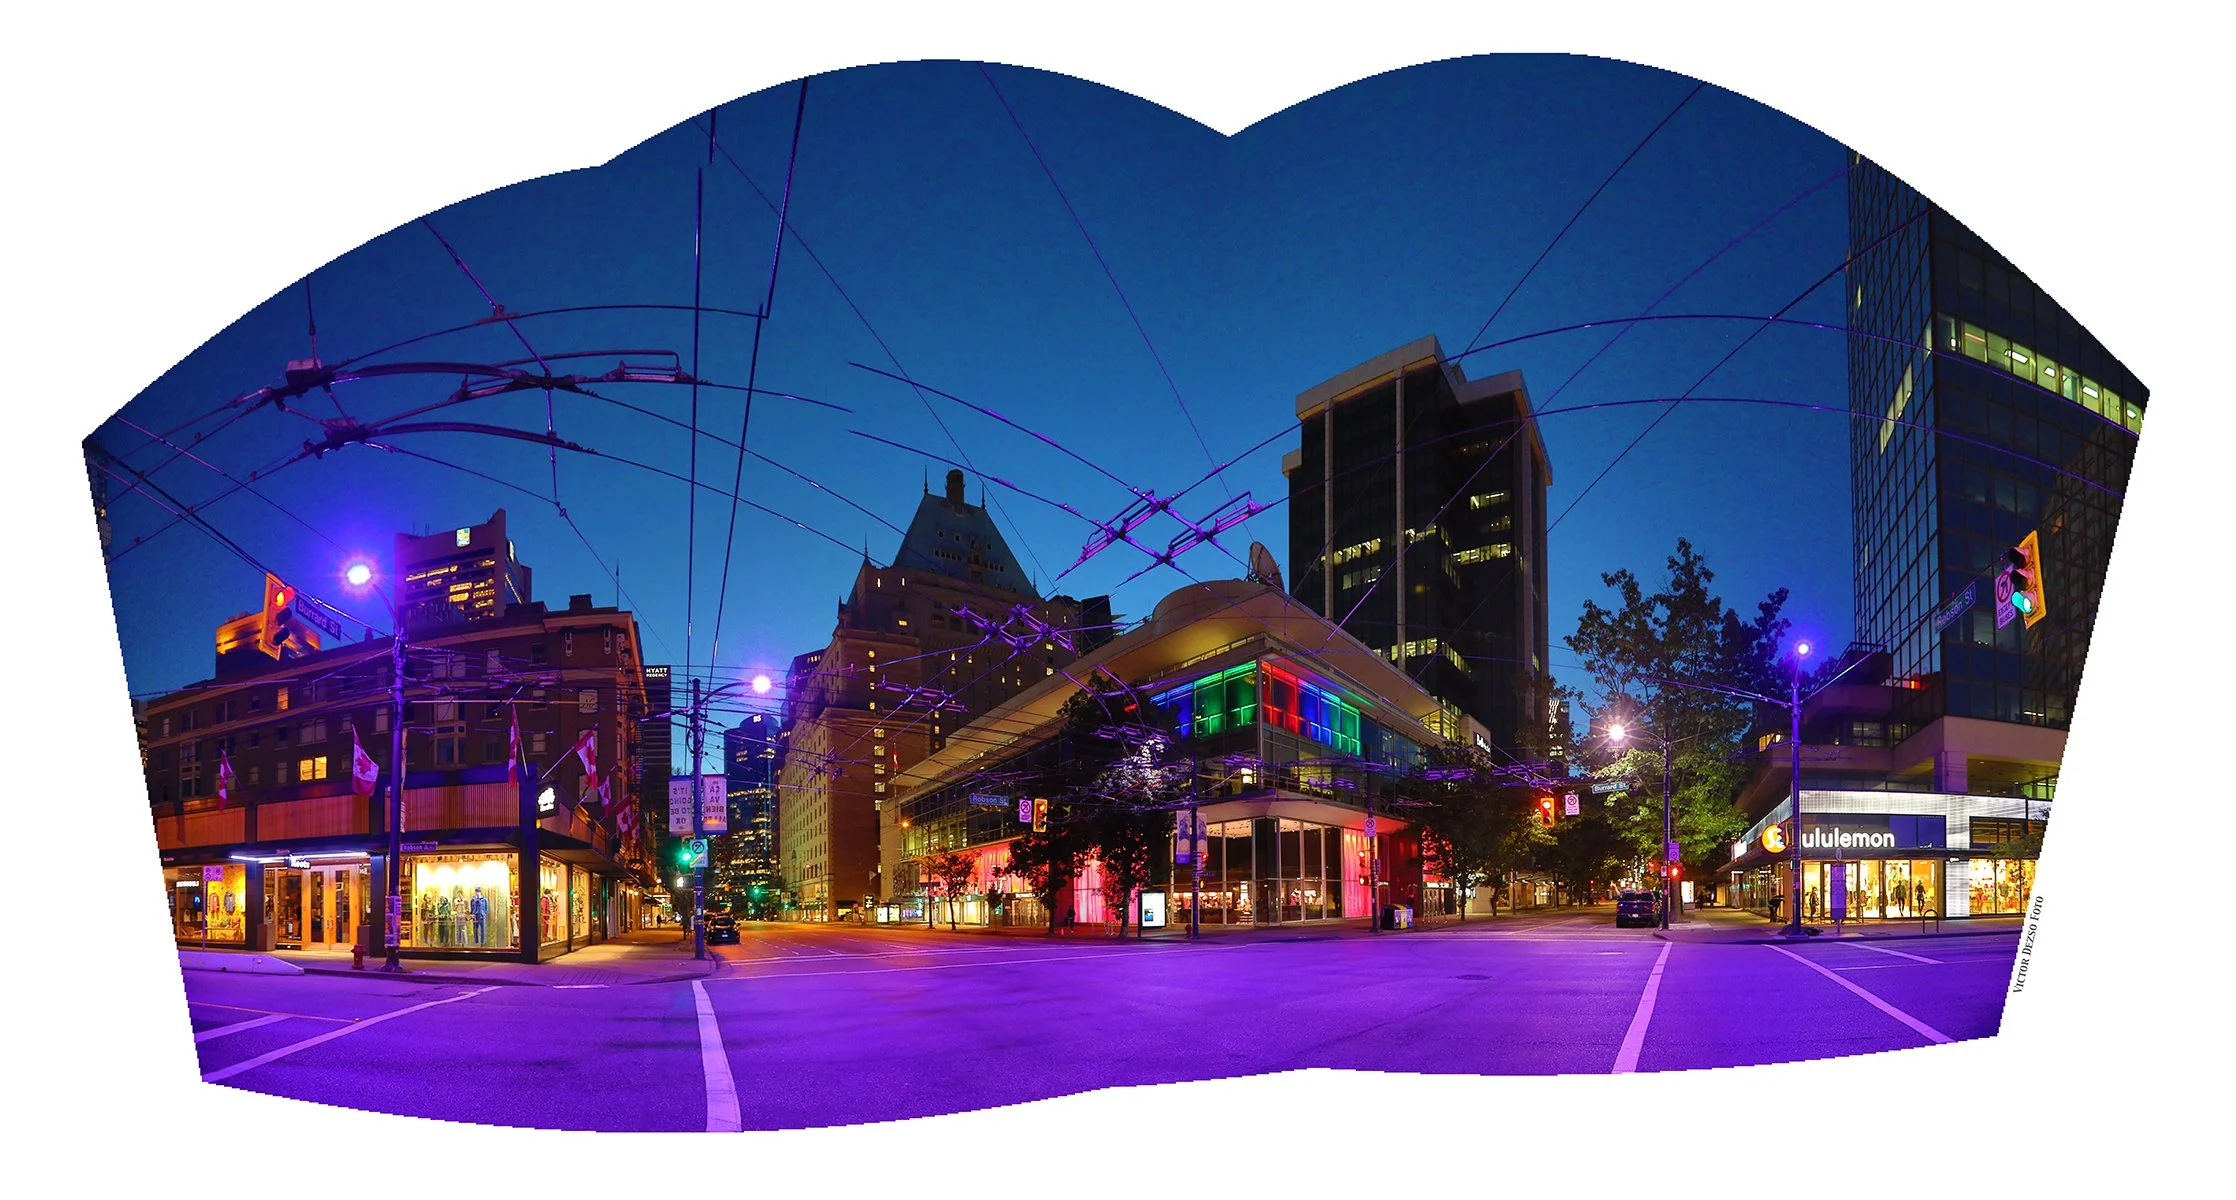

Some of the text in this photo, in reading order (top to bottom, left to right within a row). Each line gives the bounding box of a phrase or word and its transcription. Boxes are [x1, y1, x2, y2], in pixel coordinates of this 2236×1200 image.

[1965, 590, 1972, 604] St
[299, 599, 339, 636] Burrard St
[1594, 784, 1617, 792] Burrard
[972, 795, 998, 803] Robson
[1802, 827, 1895, 848] ululemon
